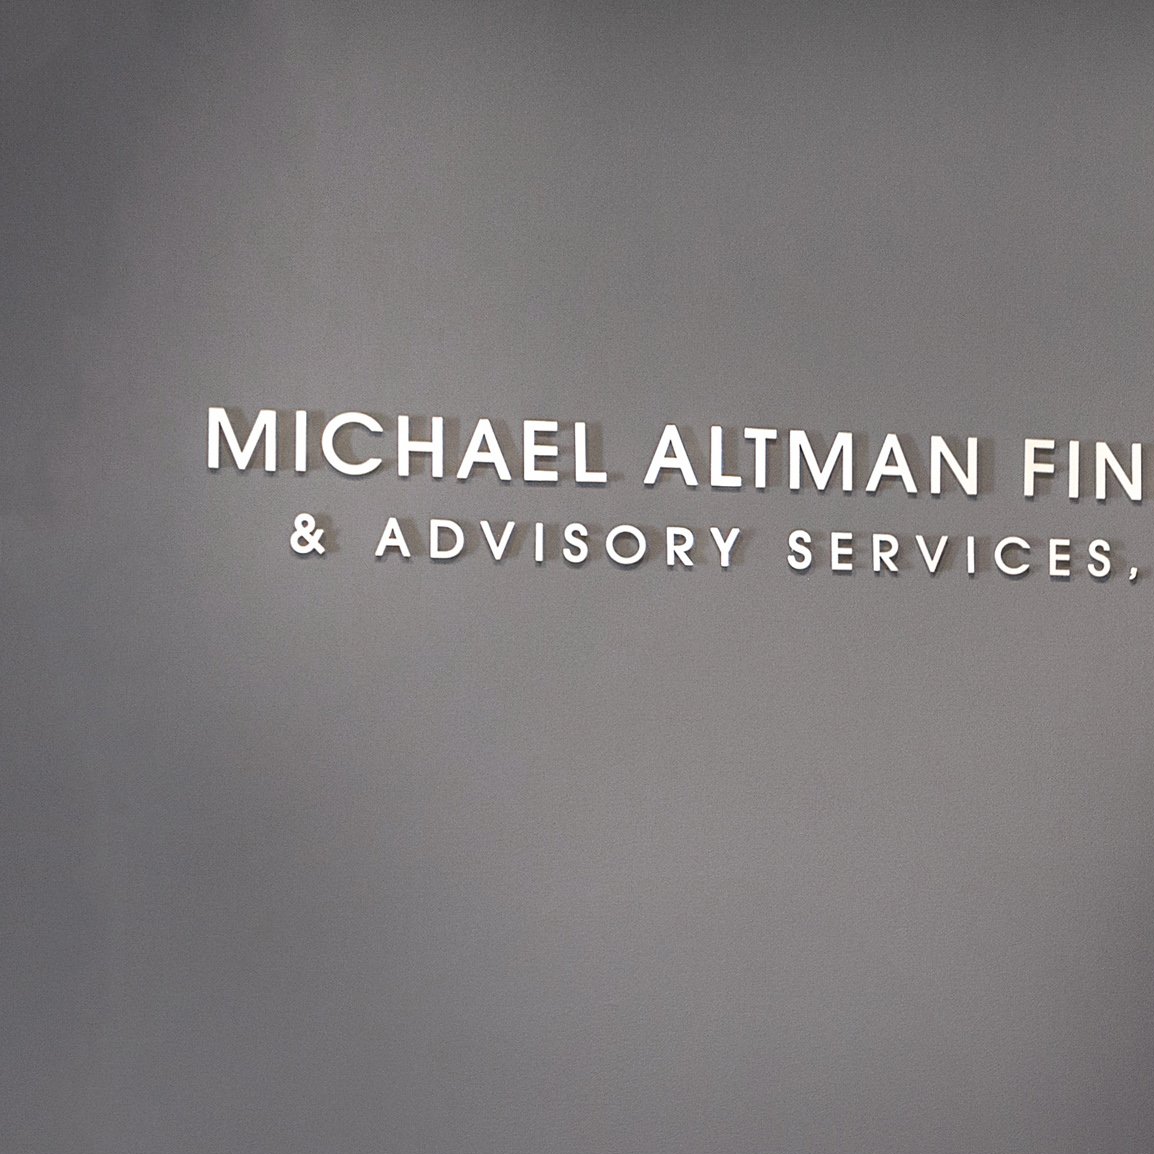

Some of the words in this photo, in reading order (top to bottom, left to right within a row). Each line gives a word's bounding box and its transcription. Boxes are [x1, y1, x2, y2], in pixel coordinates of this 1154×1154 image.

[208, 407, 607, 483] MICHAEL
[644, 423, 978, 496] ALTMAN
[290, 513, 326, 557] &
[375, 517, 741, 568] ADVISORY
[787, 529, 1139, 581] SERVICES,
